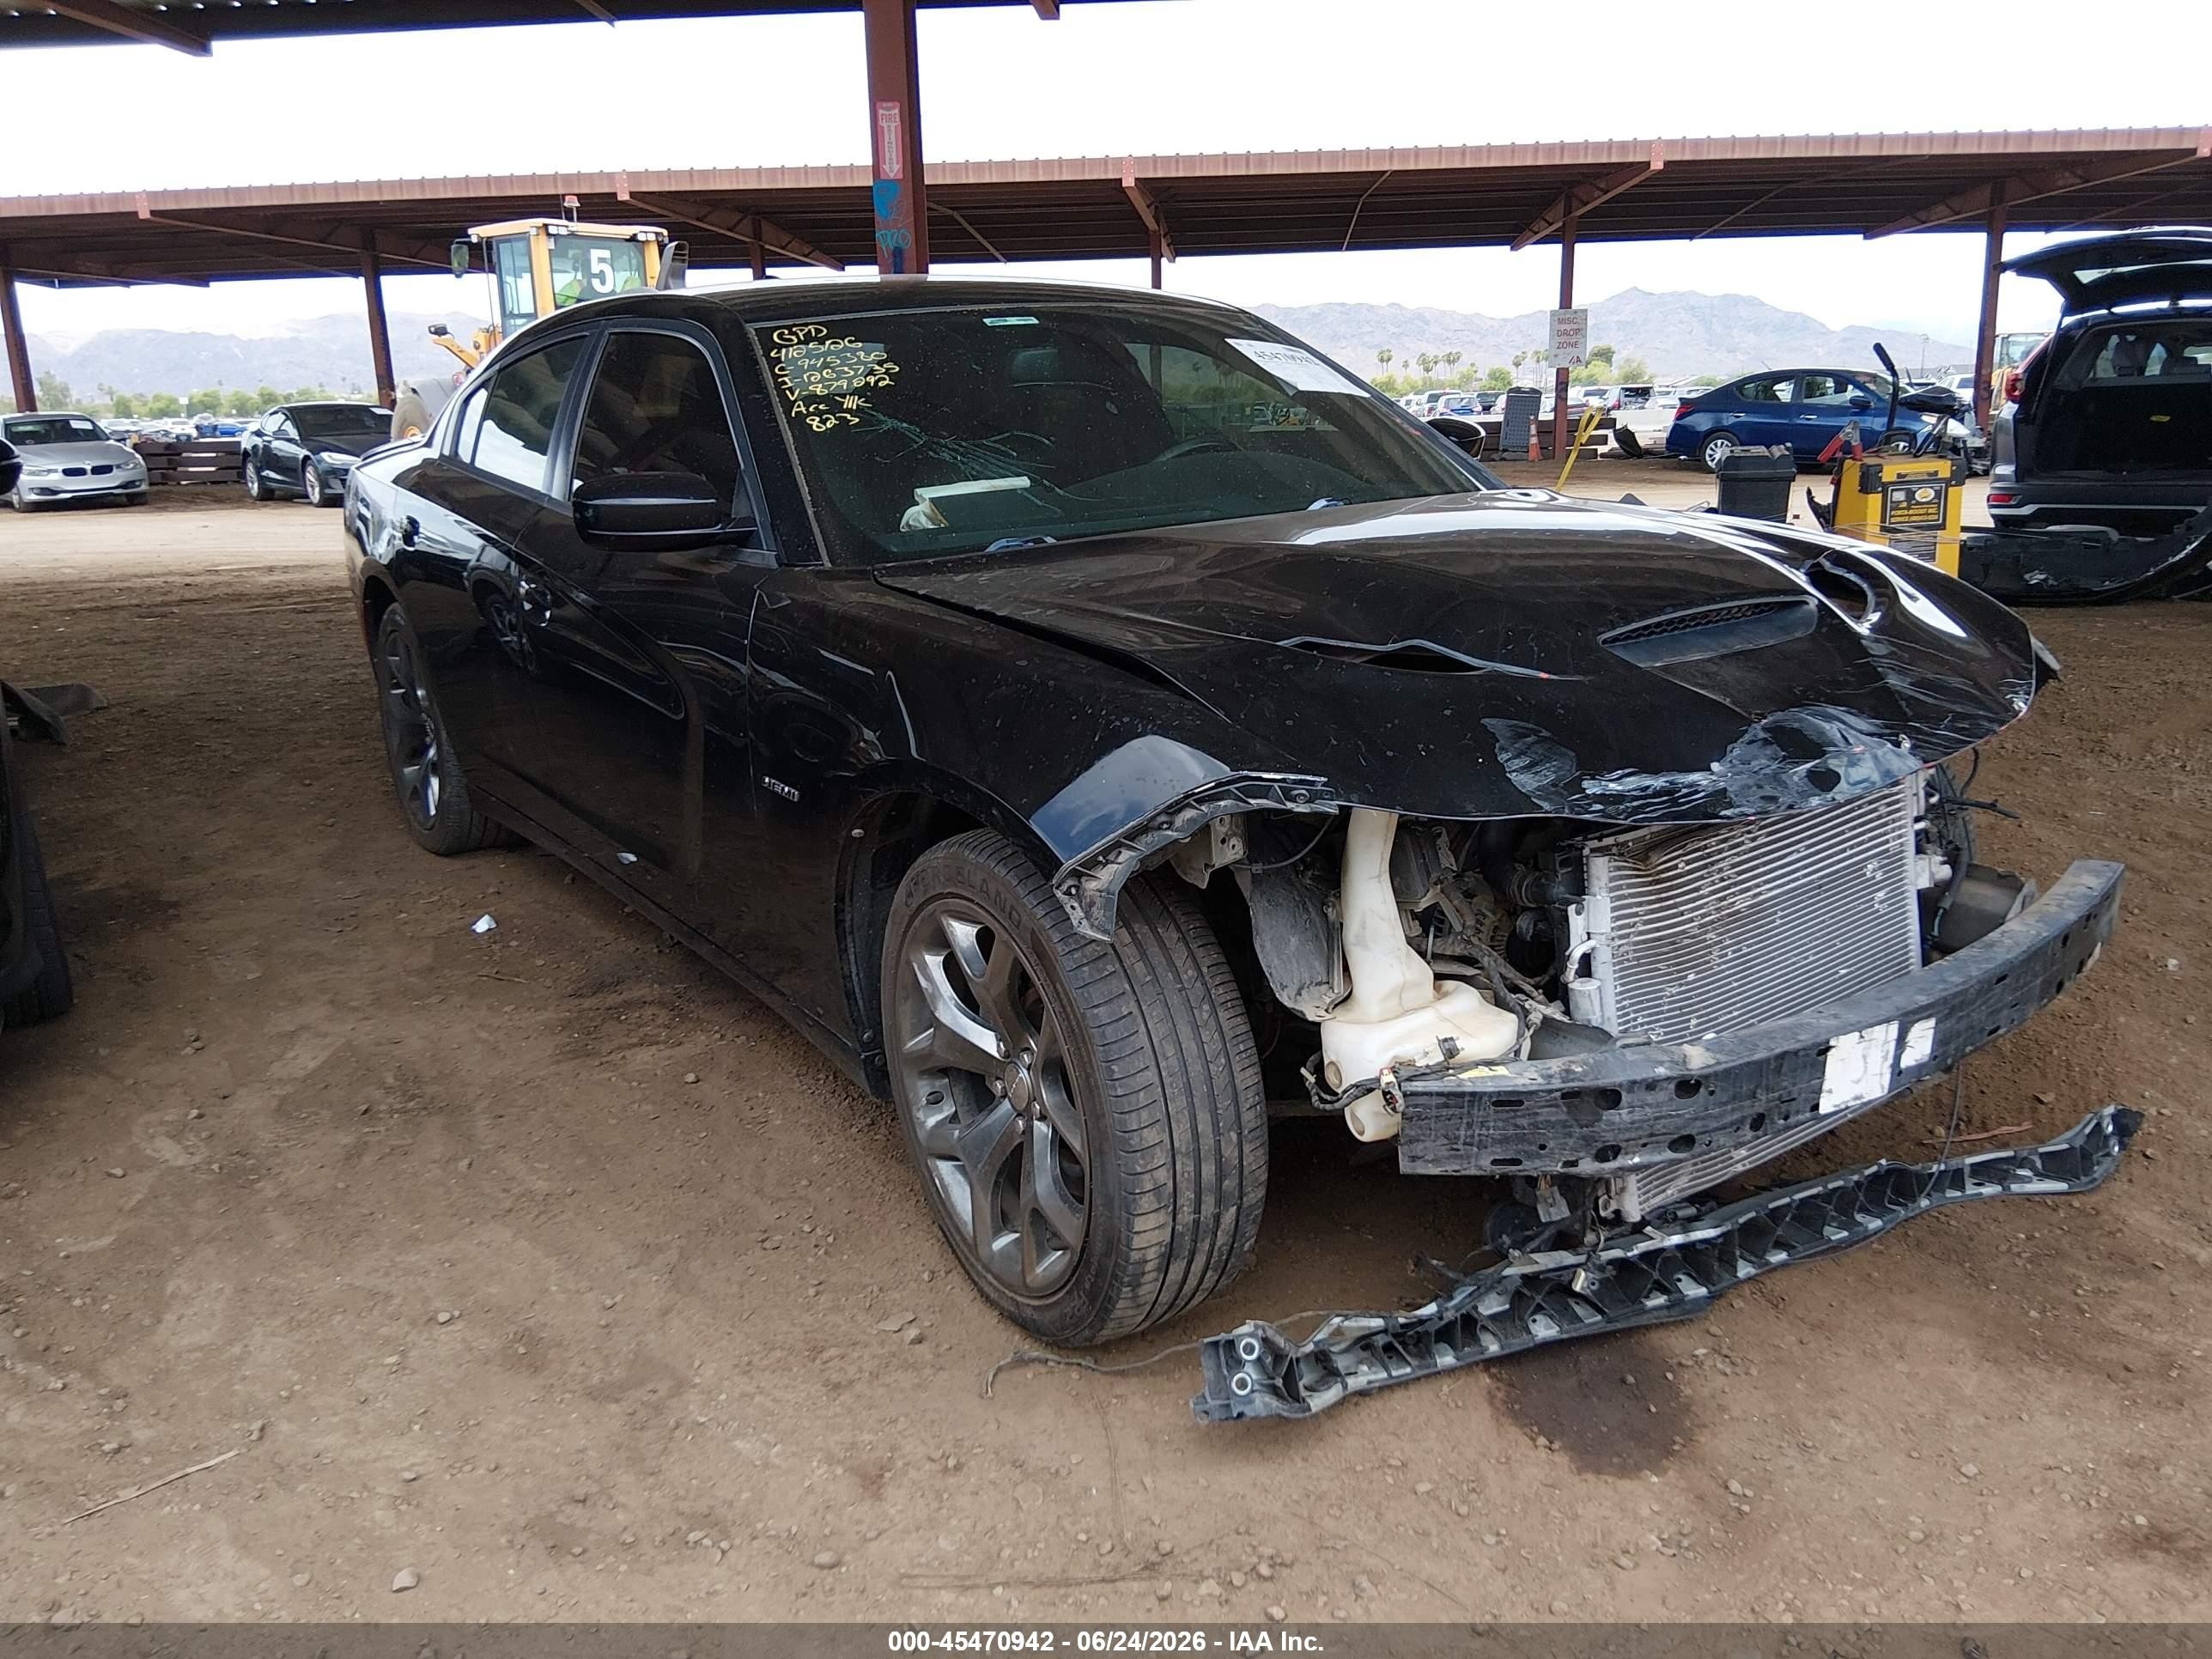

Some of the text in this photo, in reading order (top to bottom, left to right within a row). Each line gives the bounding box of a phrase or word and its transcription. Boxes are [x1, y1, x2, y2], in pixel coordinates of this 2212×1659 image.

[880, 112, 898, 124] FIRE
[590, 248, 615, 294] 5
[773, 325, 828, 344] GPD
[1556, 328, 1581, 337] DROP
[1556, 341, 1579, 349] ZONE
